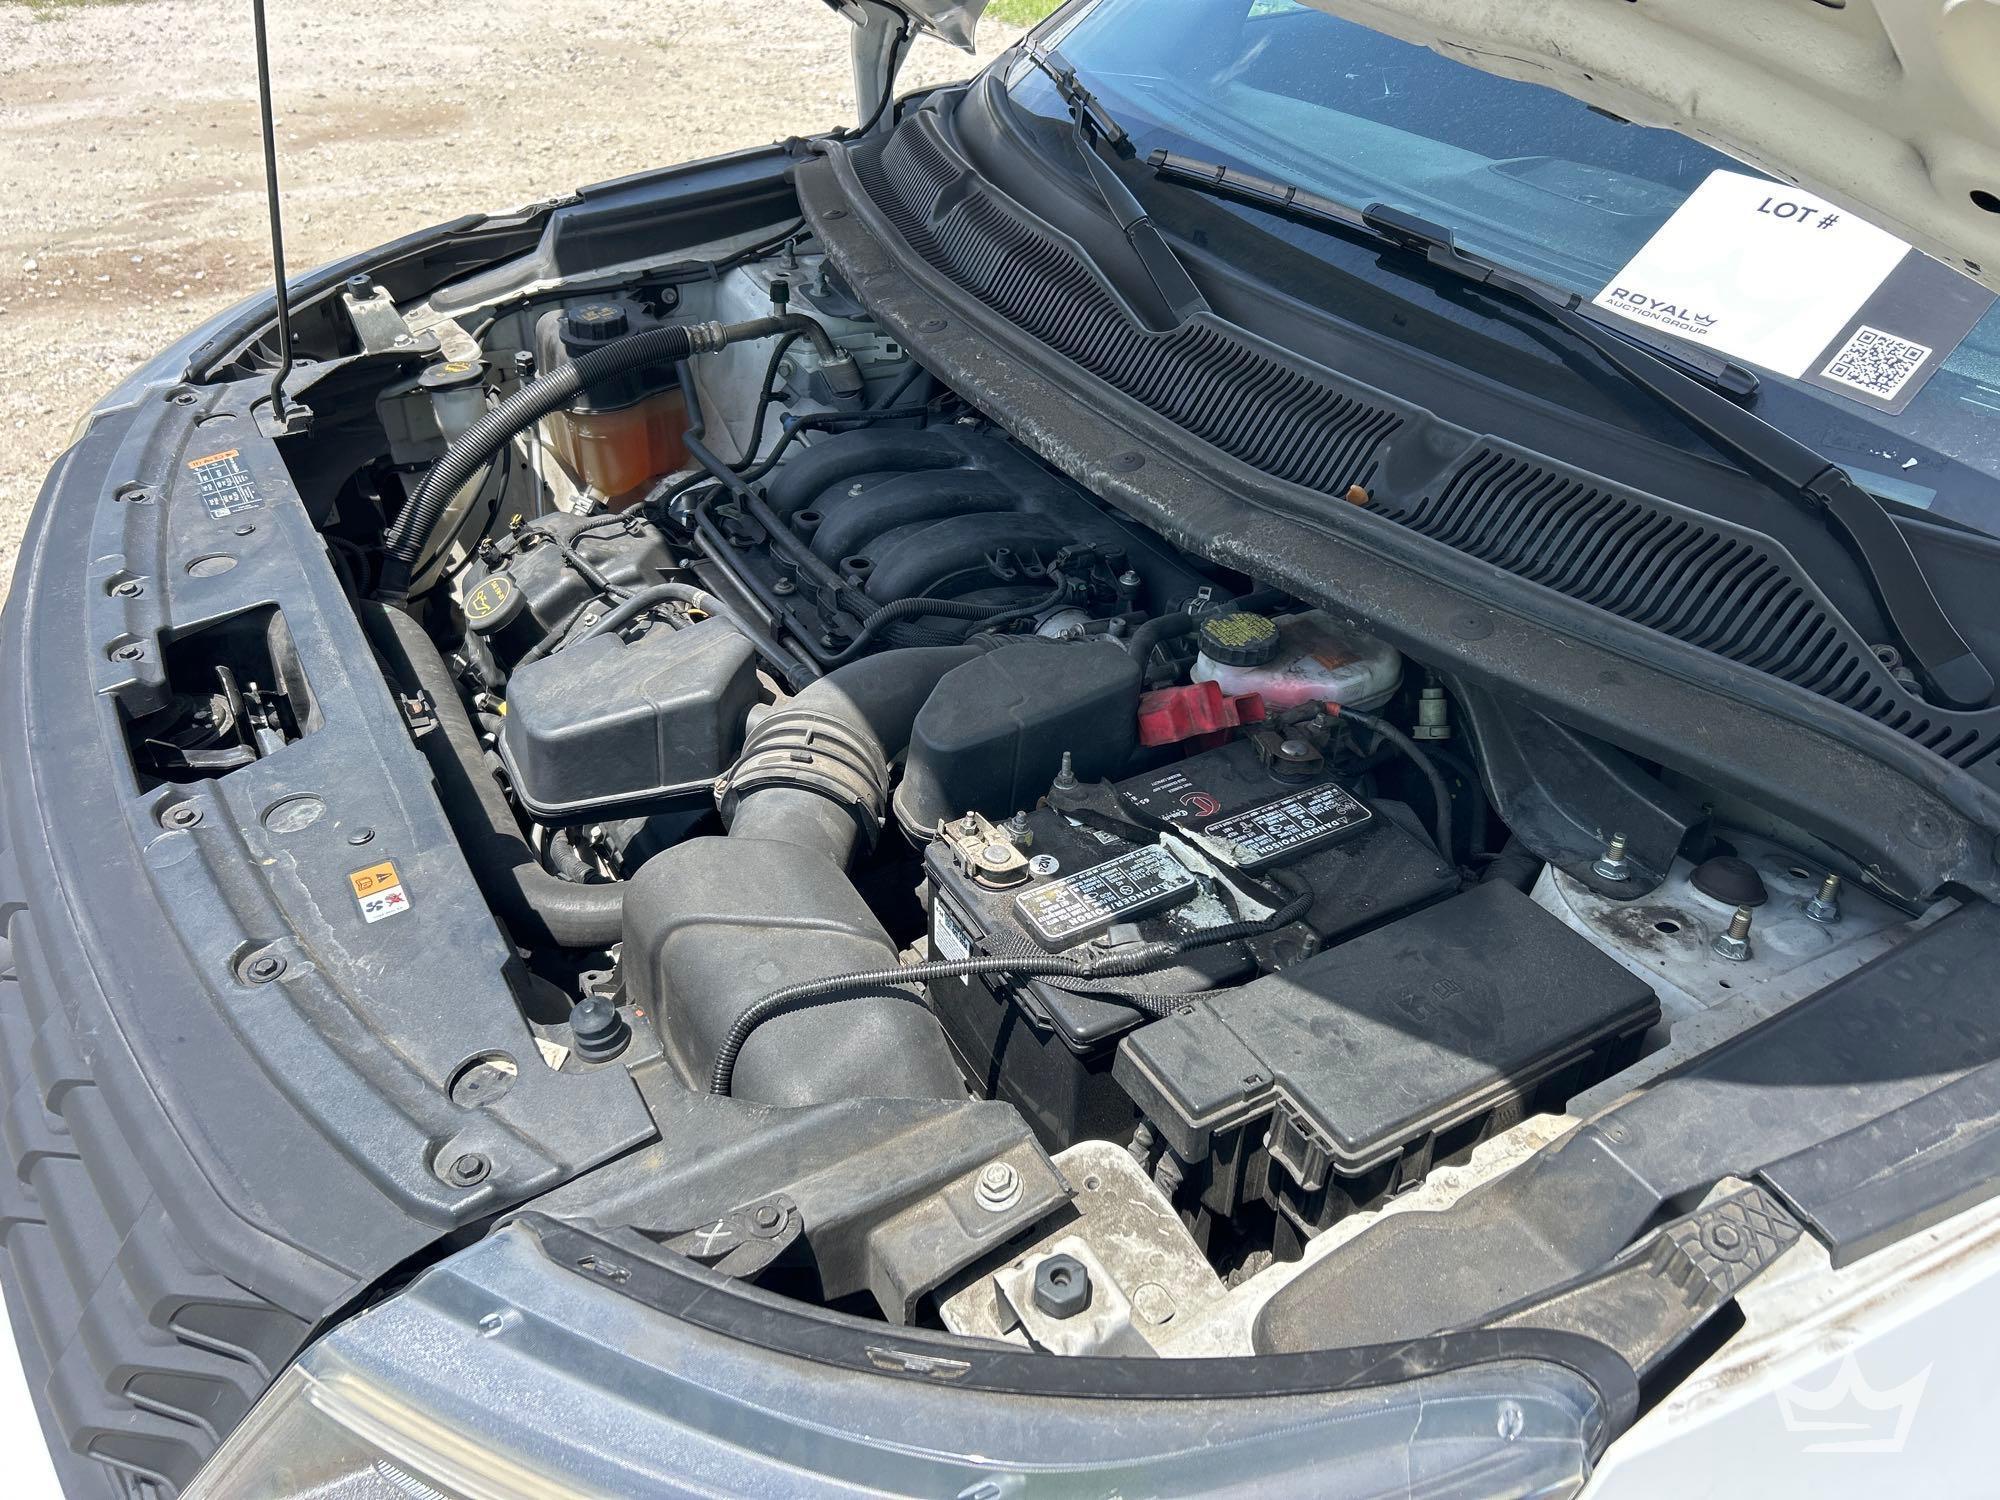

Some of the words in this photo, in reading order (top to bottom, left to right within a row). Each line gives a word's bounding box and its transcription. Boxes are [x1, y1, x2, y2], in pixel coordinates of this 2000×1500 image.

[1757, 197, 1819, 223] LOT
[1817, 213, 1840, 230] #
[1605, 298, 1661, 320] AUCTION
[1661, 316, 1708, 335] GROUP
[1611, 287, 1690, 322] ROYAL
[1256, 819, 1340, 854] DANGER/POISON
[1036, 856, 1051, 872] M24
[1067, 885, 1161, 926] DANGER/POISON
